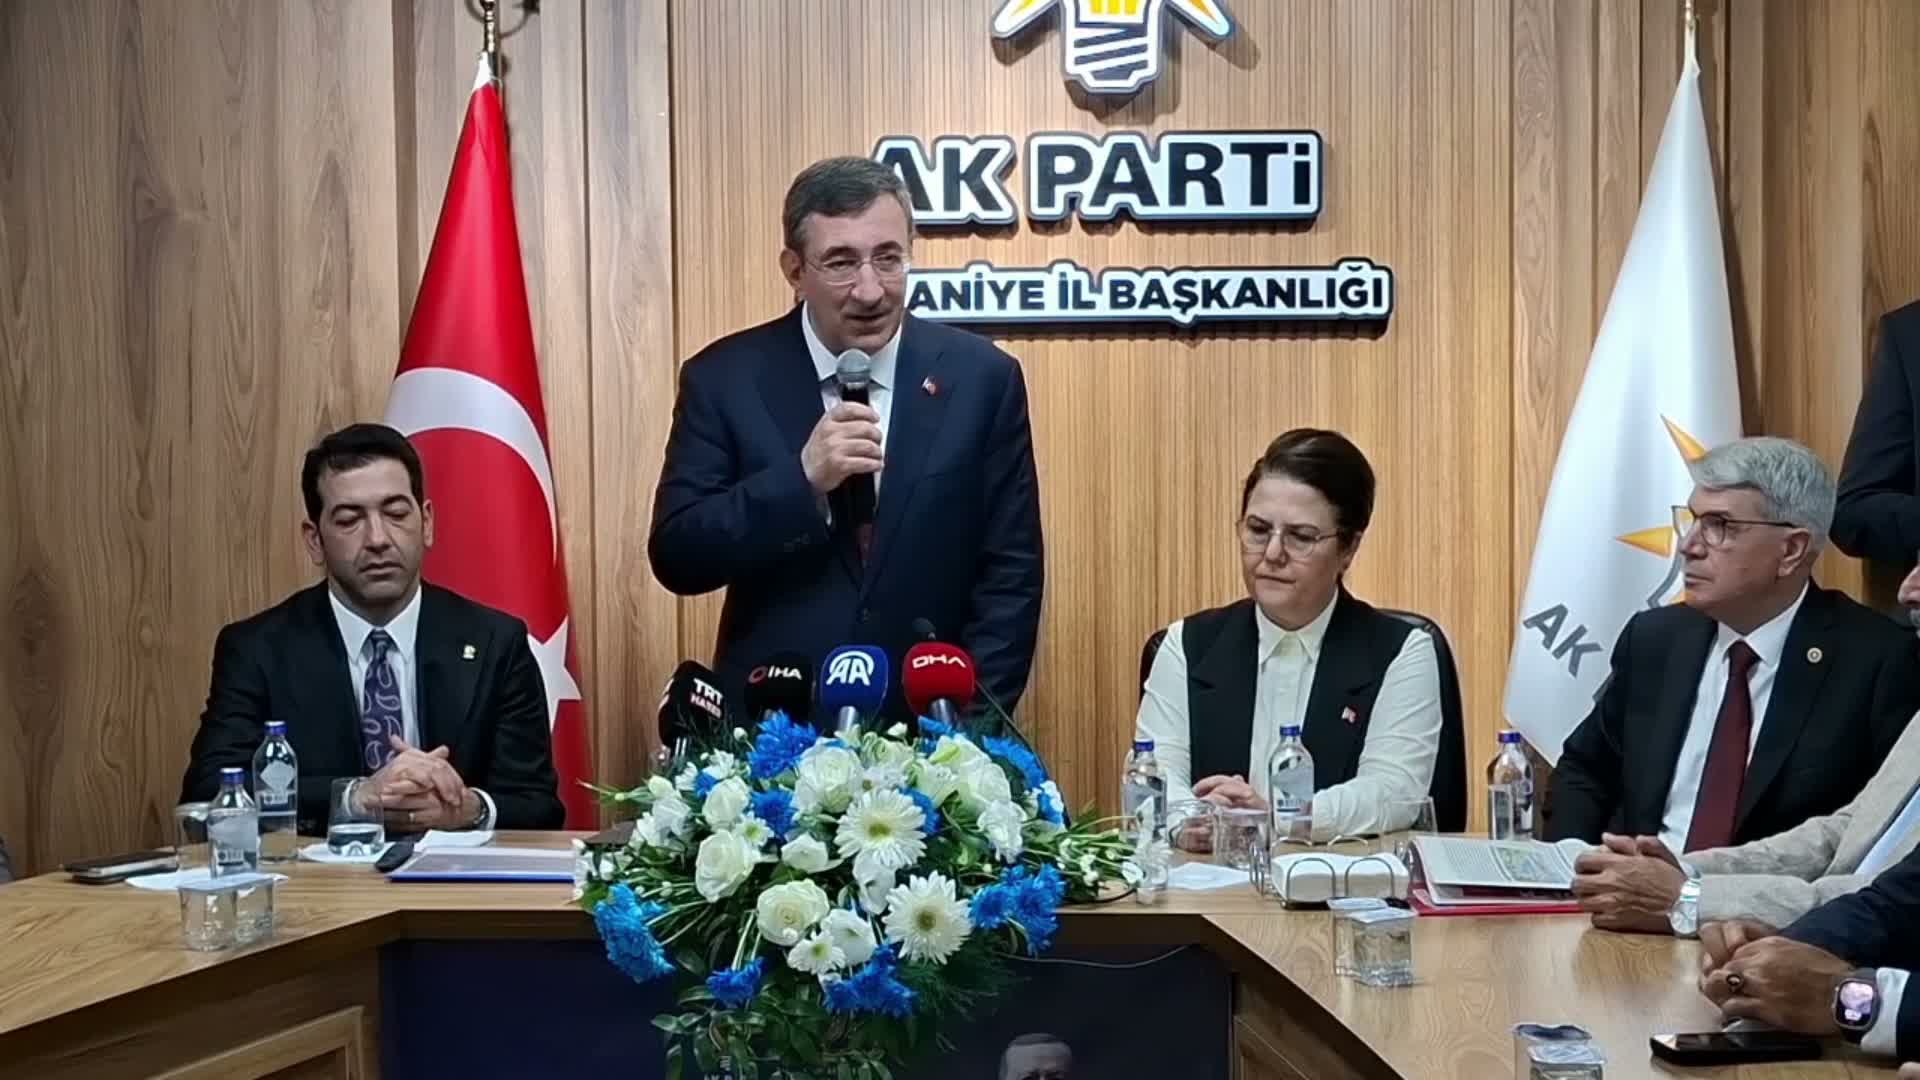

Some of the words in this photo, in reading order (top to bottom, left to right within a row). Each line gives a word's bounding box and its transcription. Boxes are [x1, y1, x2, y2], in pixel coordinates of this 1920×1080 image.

[882, 147, 1001, 212] AK
[1058, 270, 1097, 311] İL
[1108, 265, 1384, 316] BAŞKANLIĞI
[1523, 603, 1603, 678] AK
[693, 677, 723, 706] TRT
